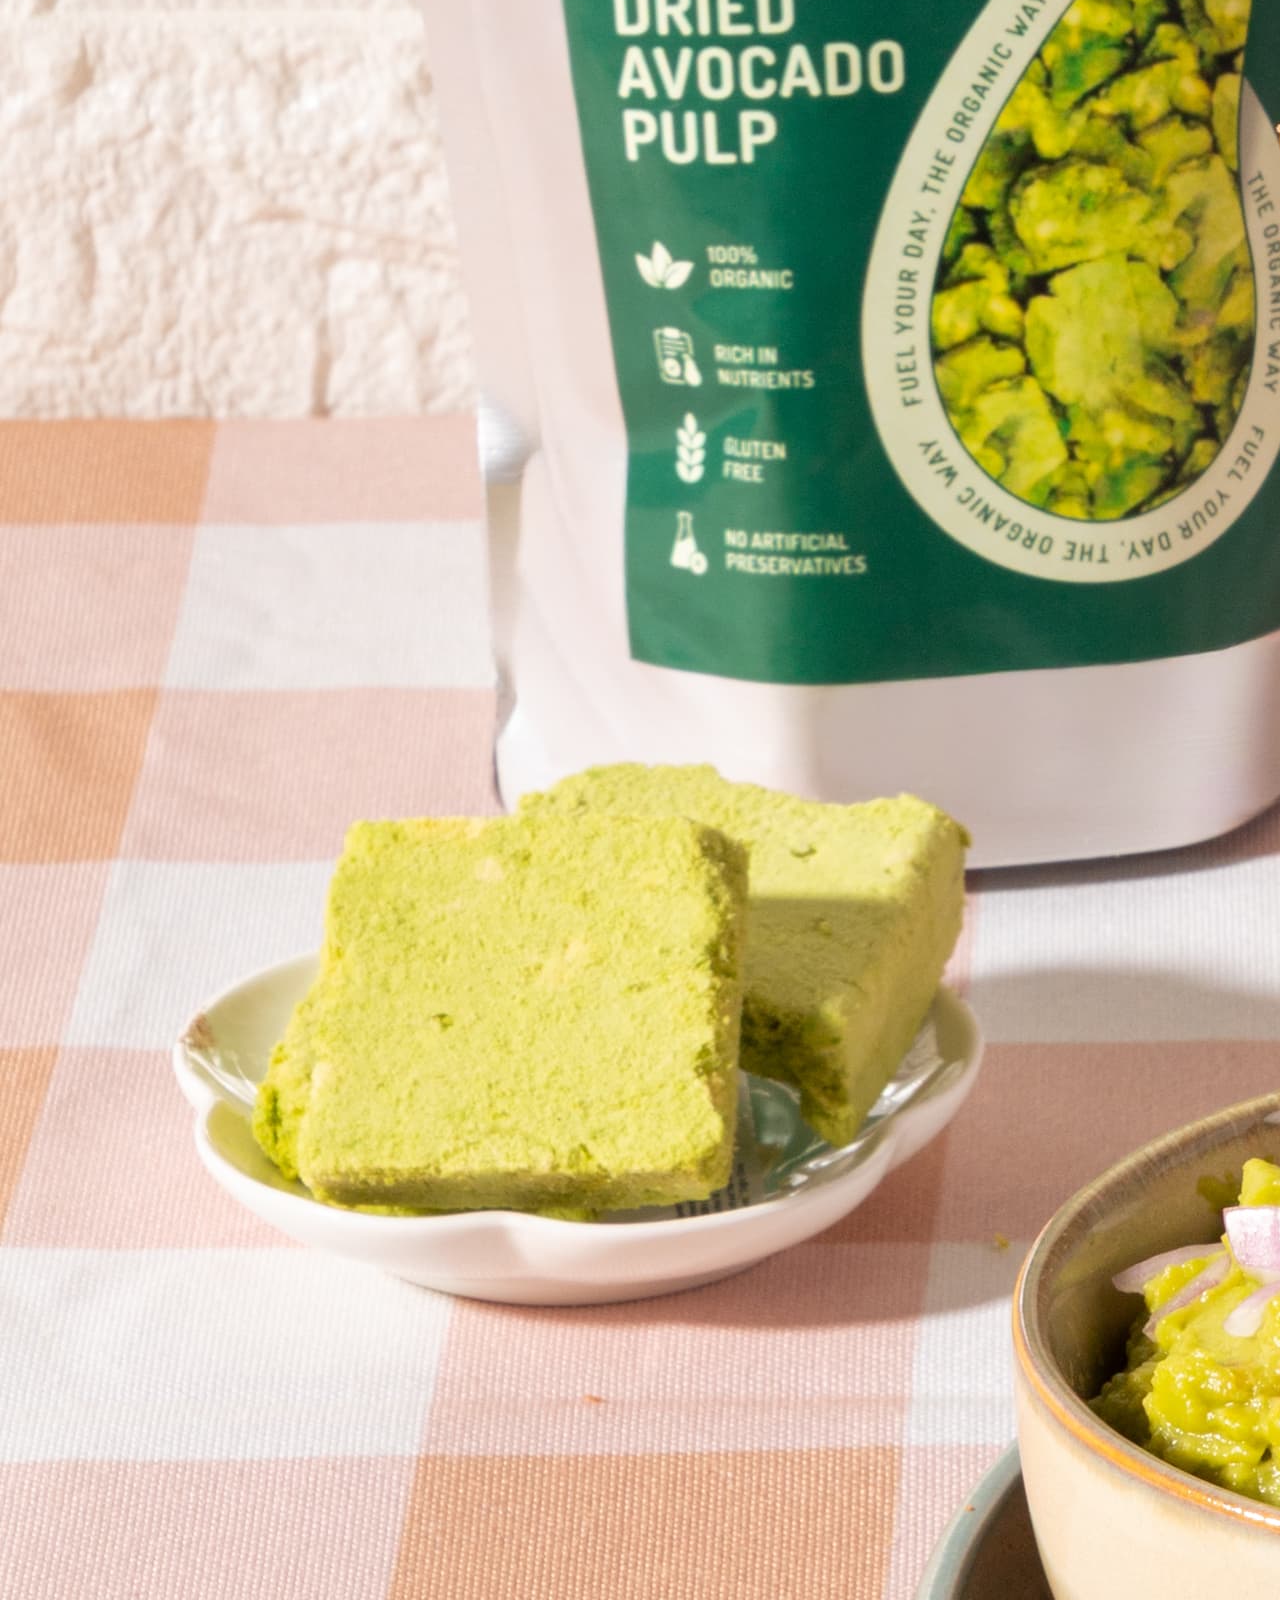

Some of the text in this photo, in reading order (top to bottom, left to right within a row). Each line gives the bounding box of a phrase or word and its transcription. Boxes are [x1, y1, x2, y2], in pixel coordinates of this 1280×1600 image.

[617, 39, 906, 100] AVOCADO
[946, 42, 1014, 144] ORGANIC
[622, 108, 778, 165] PULP
[921, 149, 957, 197] THE
[1246, 170, 1275, 219] THE
[705, 245, 758, 265] 100%
[708, 268, 794, 290] ORGANIC
[894, 268, 919, 336] YOUR
[713, 344, 778, 365] RICH IN
[895, 344, 924, 409] FUEL
[716, 368, 816, 390] NUTRIENTS
[722, 436, 787, 461] GLUTEN
[722, 461, 765, 483] FREE
[918, 439, 960, 489] WAY
[1226, 424, 1265, 484] FUEL
[956, 485, 1054, 555] ORGANIC
[1180, 488, 1231, 542] YOUR
[724, 528, 849, 551] NO ARTIFICIAL
[1062, 540, 1111, 564] THE
[725, 552, 868, 576] PRESERVATIVES
